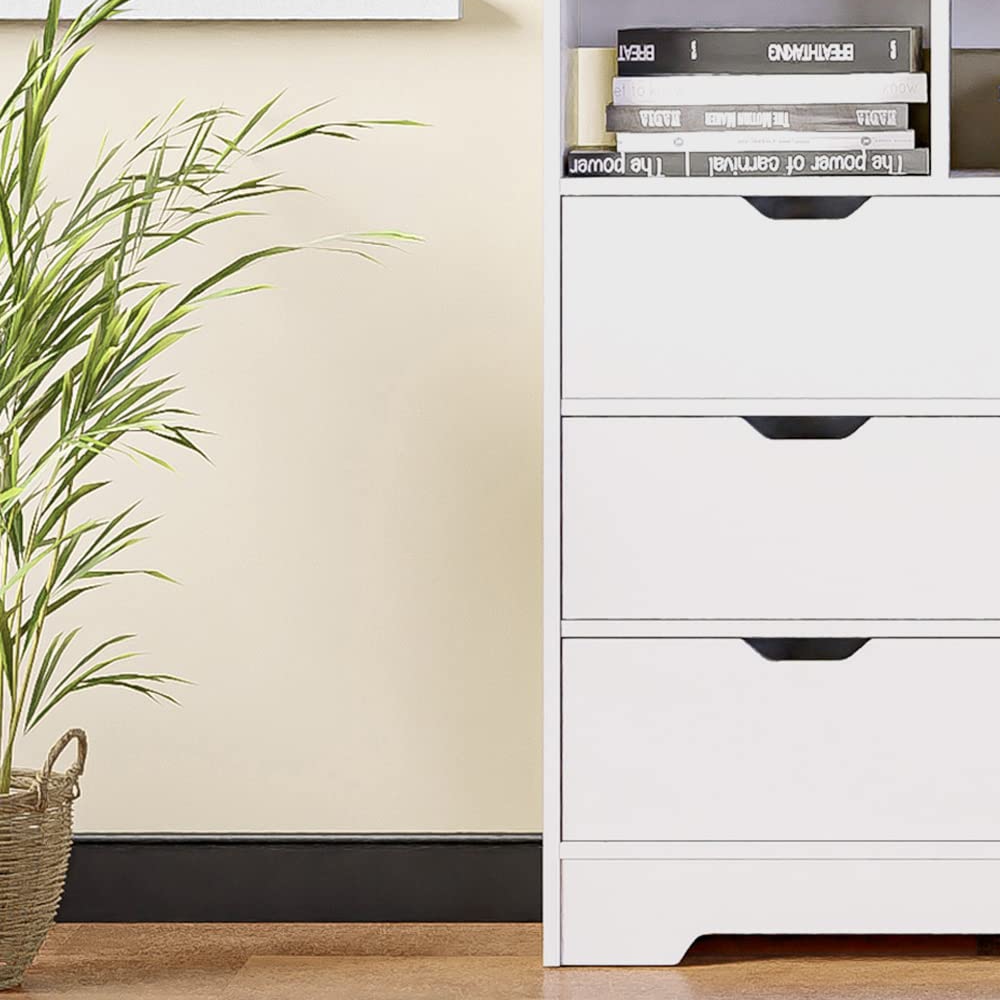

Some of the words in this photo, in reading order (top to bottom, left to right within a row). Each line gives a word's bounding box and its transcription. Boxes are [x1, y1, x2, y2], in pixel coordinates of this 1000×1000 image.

[569, 151, 626, 174] power
[630, 157, 666, 177] The
[708, 155, 780, 177] carnival
[786, 155, 805, 176] of
[811, 149, 867, 170] power
[872, 154, 906, 175] The
